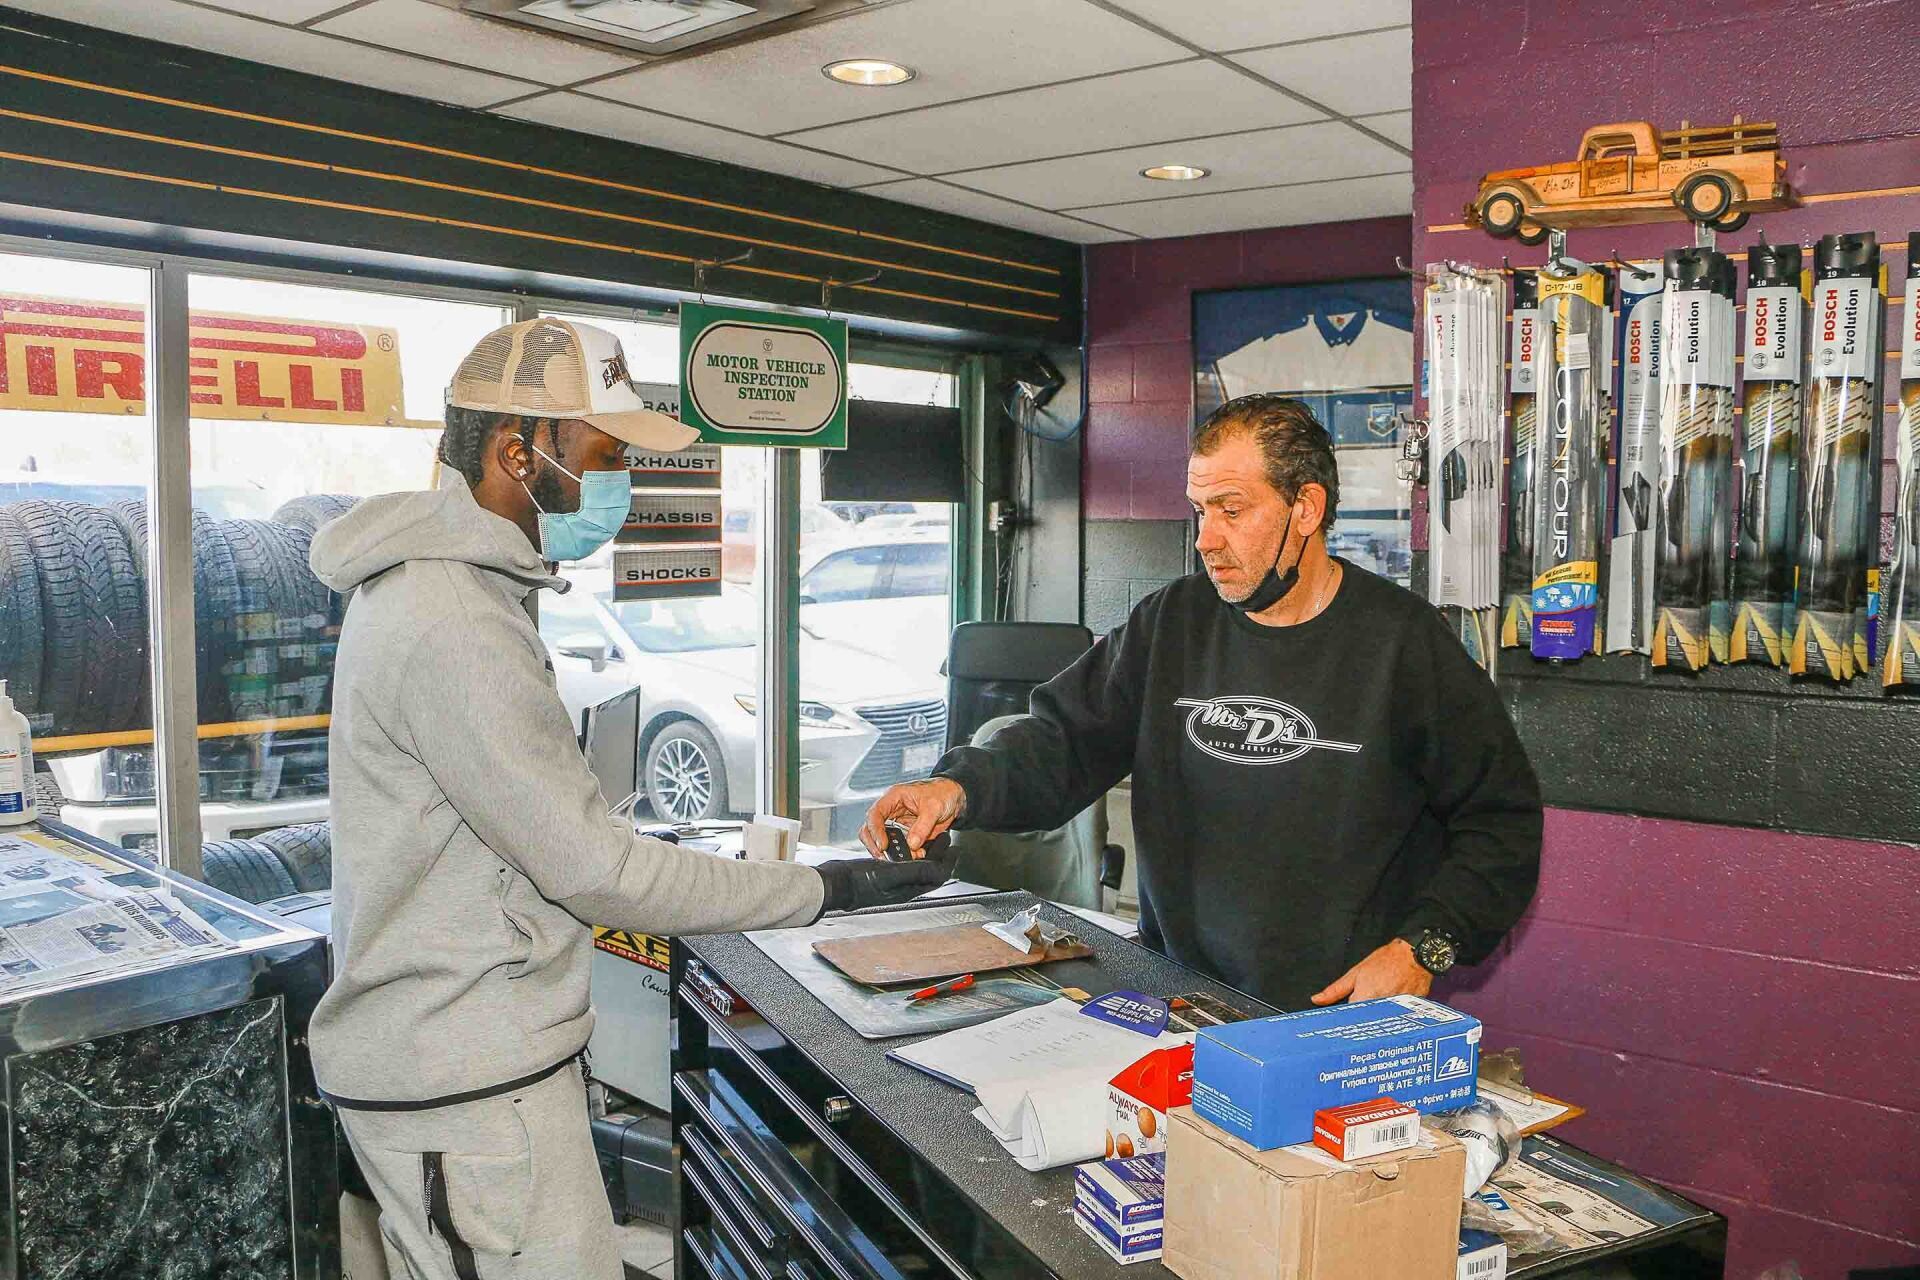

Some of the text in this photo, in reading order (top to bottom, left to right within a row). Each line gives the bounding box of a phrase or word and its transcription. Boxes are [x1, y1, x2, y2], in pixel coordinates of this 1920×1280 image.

[1755, 297, 1768, 346] BOSCH
[1824, 289, 1838, 341] BOSCH
[1843, 289, 1859, 355] Evolution
[1687, 301, 1700, 363] Evolution
[1774, 297, 1788, 359] Evolution
[1520, 318, 1533, 362] BOSCH
[1630, 320, 1642, 364] BOSCH
[1649, 319, 1661, 378] Evolution
[707, 354, 826, 375] MOTOR VEHICLE
[724, 370, 809, 388] INSPECTION
[738, 387, 796, 402] STATION
[624, 456, 716, 469] EXHAUST
[625, 513, 713, 524] CHASSIS
[626, 567, 711, 580] SHOCKS
[1245, 709, 1297, 745] D's
[1207, 740, 1286, 754] AUTO SERVICE
[1125, 1001, 1163, 1017] RPG
[1350, 1040, 1433, 1064] Peças Originais ATE
[1417, 1052, 1432, 1062] ATE
[1416, 1063, 1432, 1074] ATE
[1396, 1080, 1413, 1091] ATE
[1109, 1091, 1138, 1115] ALWAYS
[1344, 1107, 1409, 1124] STANDARD
[1314, 1126, 1341, 1145] STANDARD
[1128, 1203, 1162, 1215] ACDelco
[1128, 1233, 1162, 1245] ACDelco
